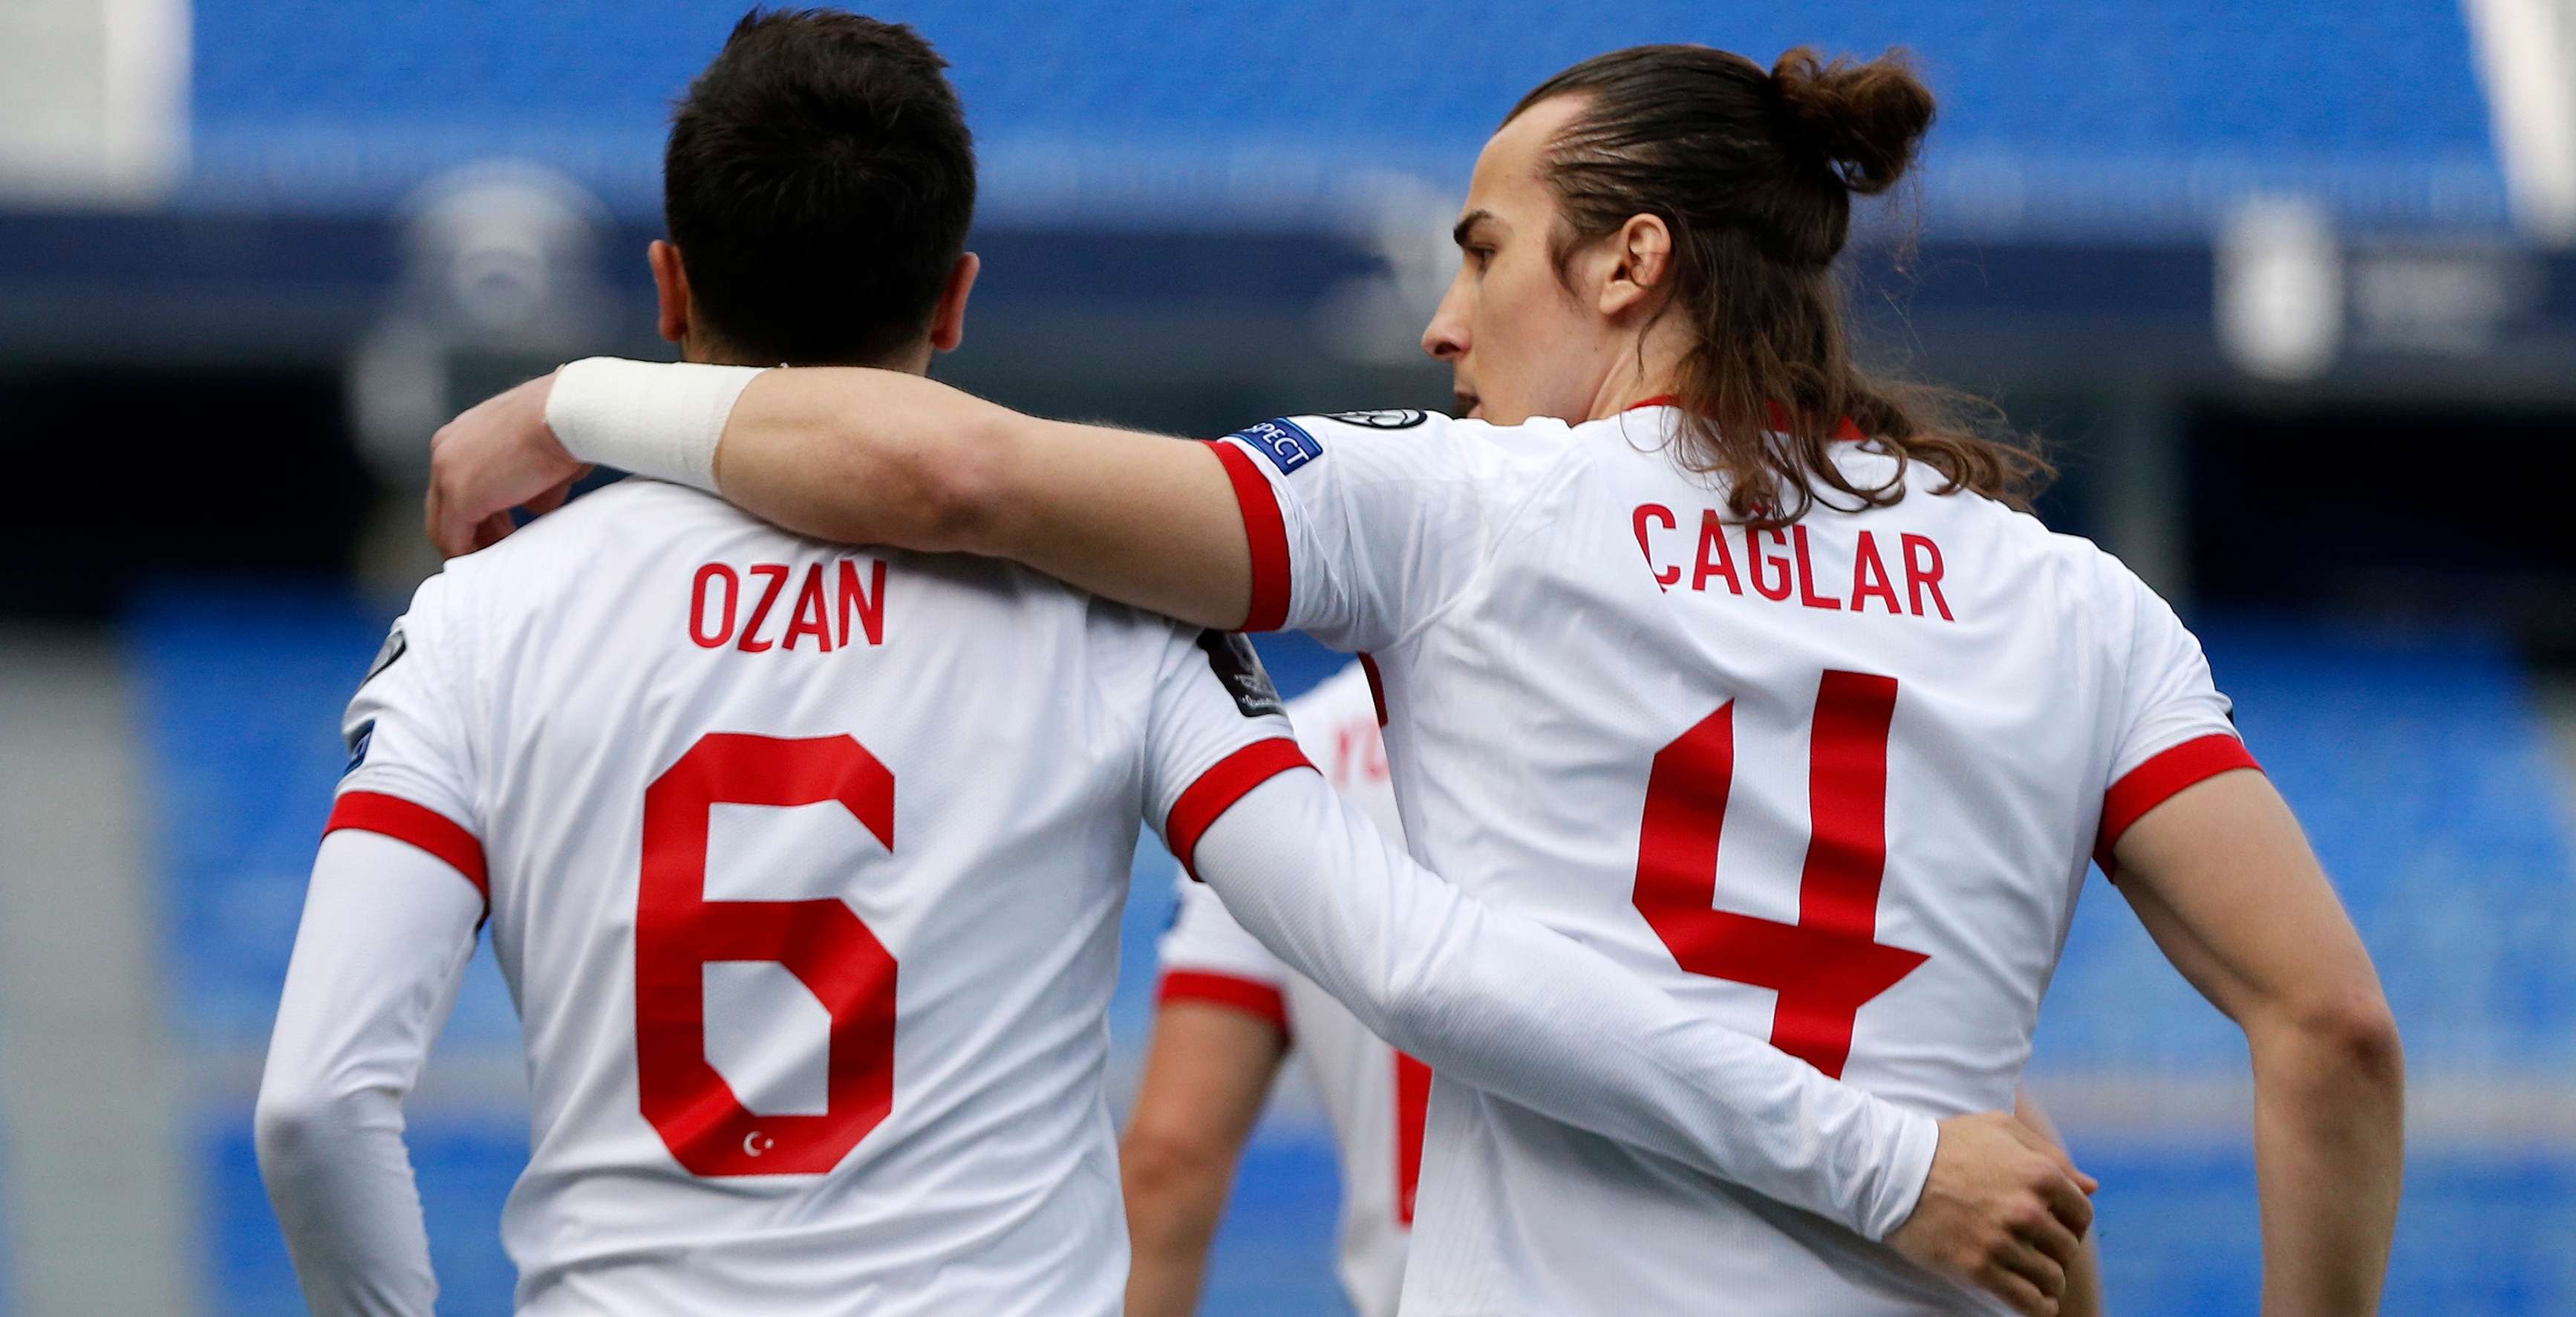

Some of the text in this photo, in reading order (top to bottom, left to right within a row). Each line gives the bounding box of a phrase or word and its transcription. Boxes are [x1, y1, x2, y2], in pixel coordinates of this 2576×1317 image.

[1243, 422, 1310, 465] PECT
[689, 559, 887, 653] OZAN
[635, 732, 899, 1177] 6
[1632, 669, 1931, 1081] 4
